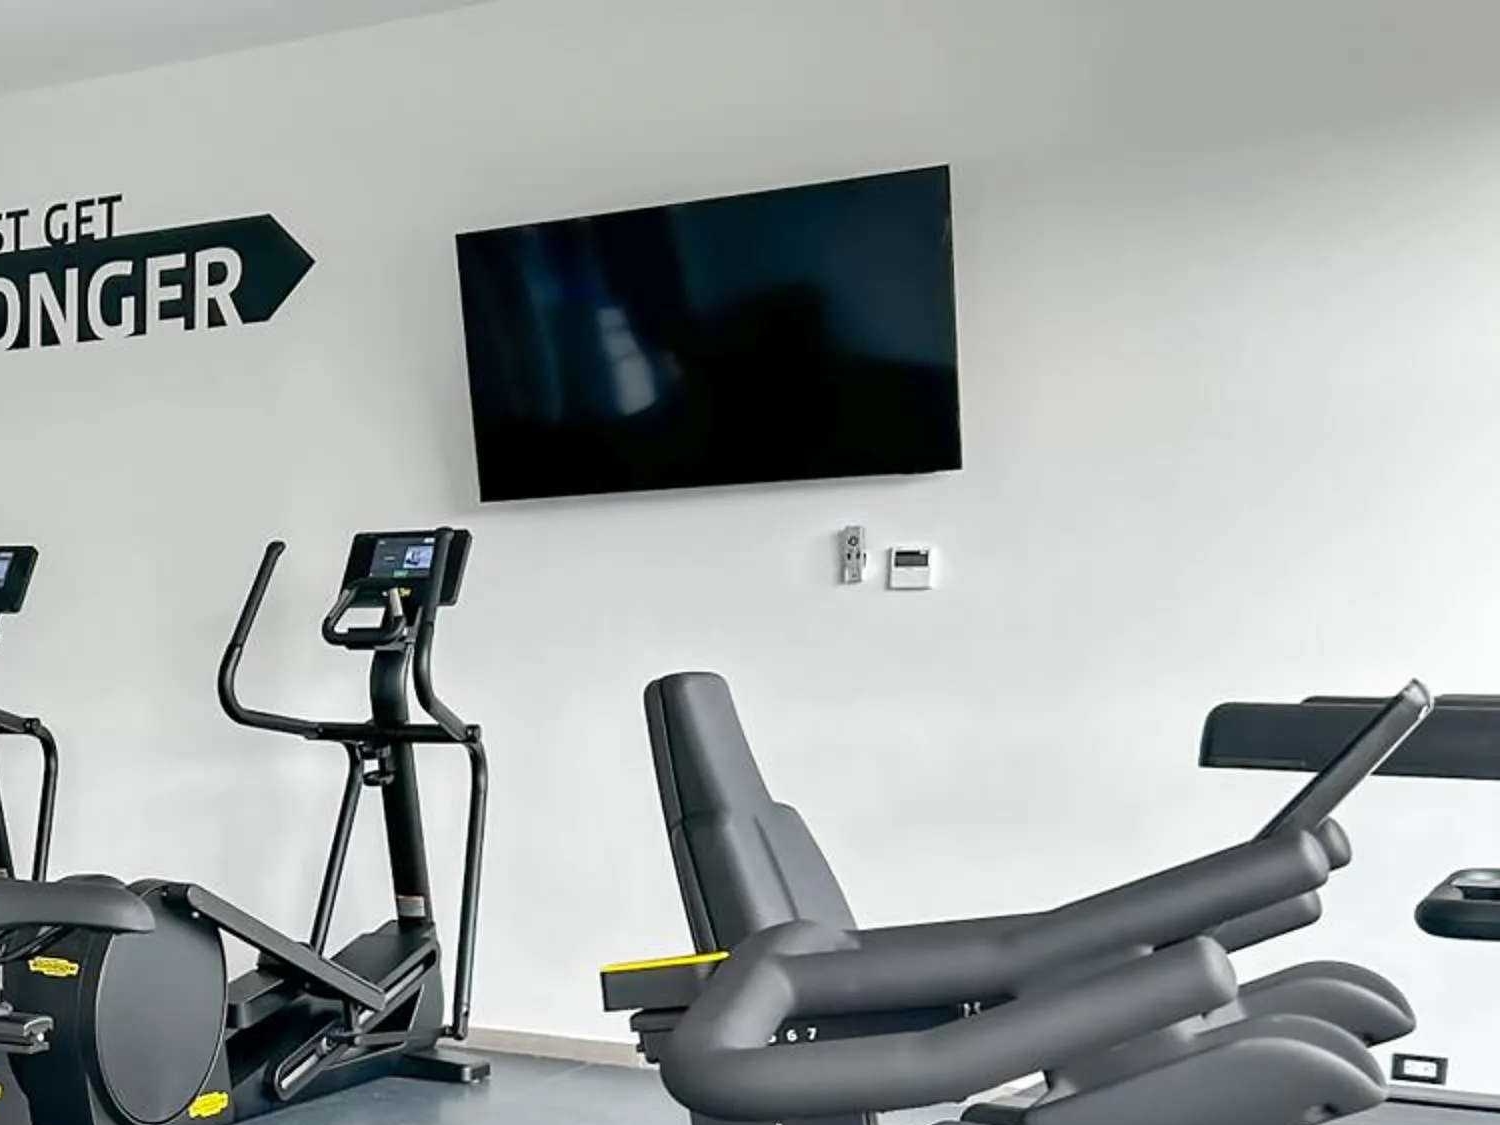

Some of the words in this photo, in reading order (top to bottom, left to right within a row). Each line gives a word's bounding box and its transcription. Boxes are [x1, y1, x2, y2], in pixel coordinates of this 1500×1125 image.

[44, 193, 123, 246] GET
[786, 1029, 797, 1042] 6
[807, 1027, 817, 1040] 7
